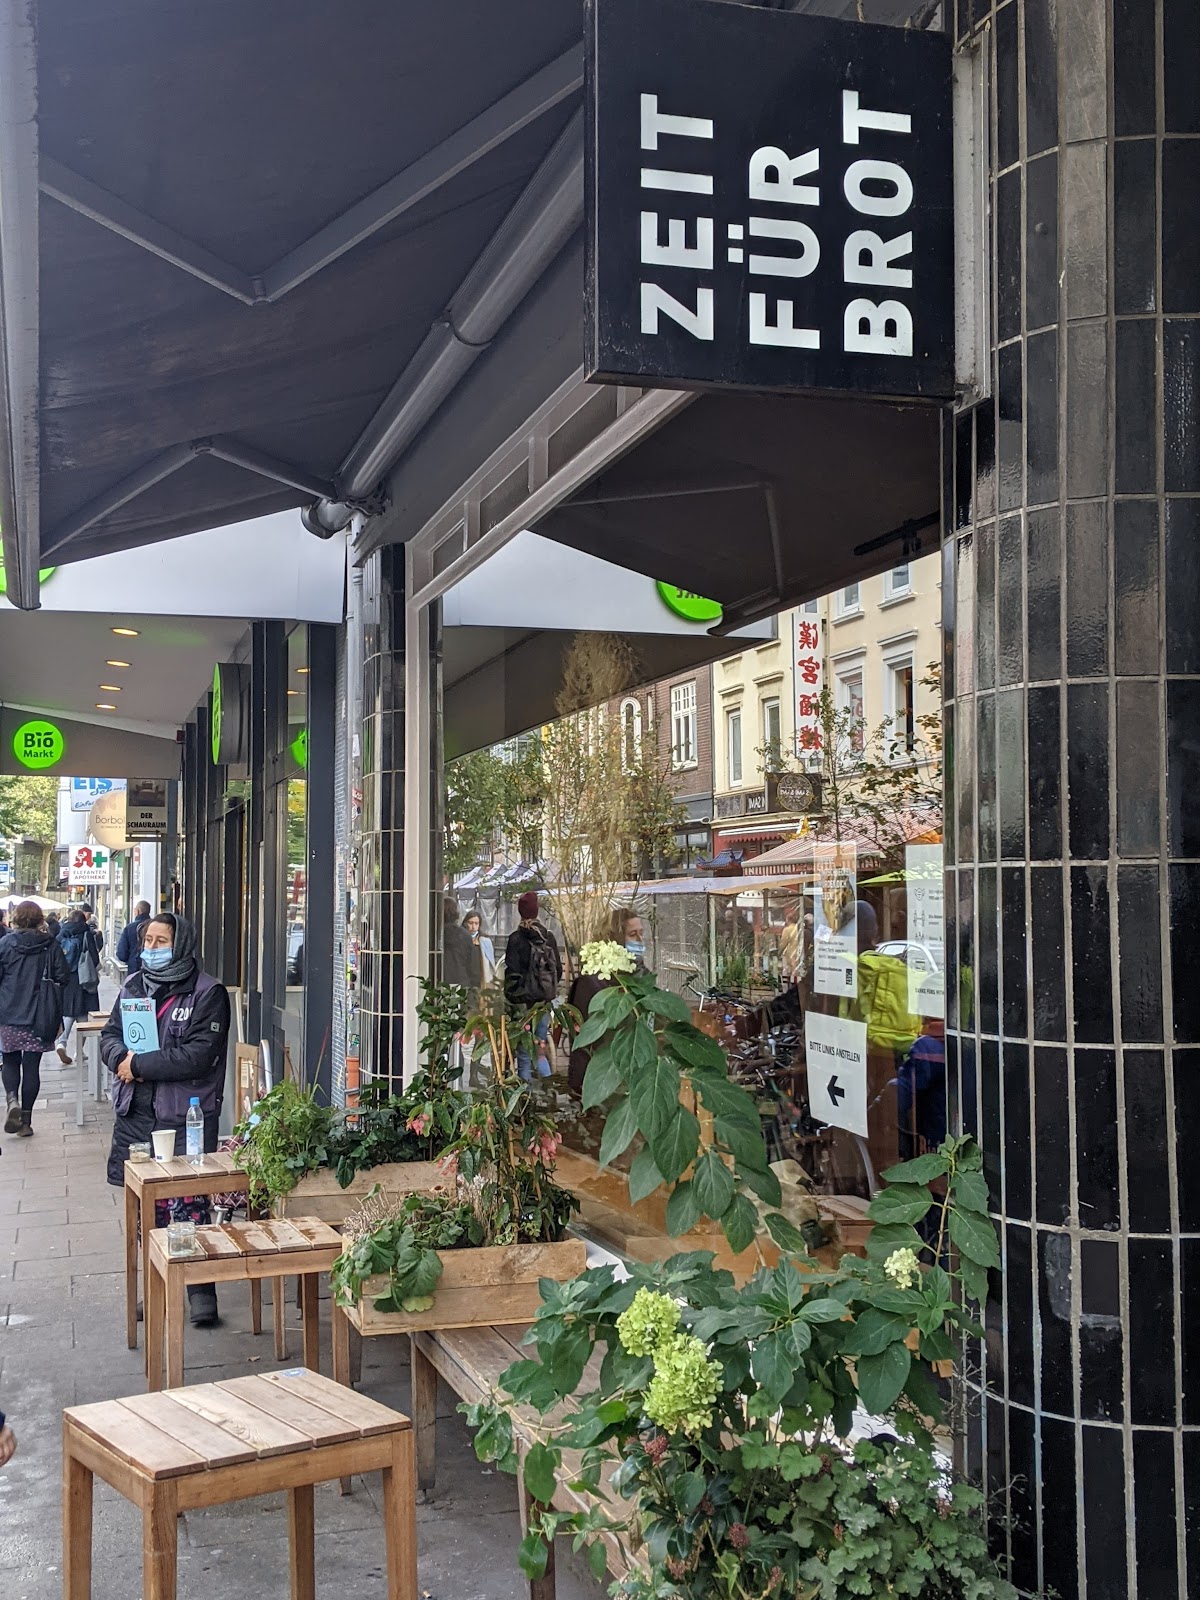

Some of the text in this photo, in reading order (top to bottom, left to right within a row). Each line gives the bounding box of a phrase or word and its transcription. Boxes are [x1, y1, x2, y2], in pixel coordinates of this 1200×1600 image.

[641, 93, 714, 341] ZEIT
[728, 146, 820, 349] FÜR
[842, 89, 913, 357] BROT
[23, 750, 54, 758] Markt
[127, 821, 167, 829] SCHAURAUM
[809, 1040, 861, 1063] BITTE LINKS ANSTELLEN
